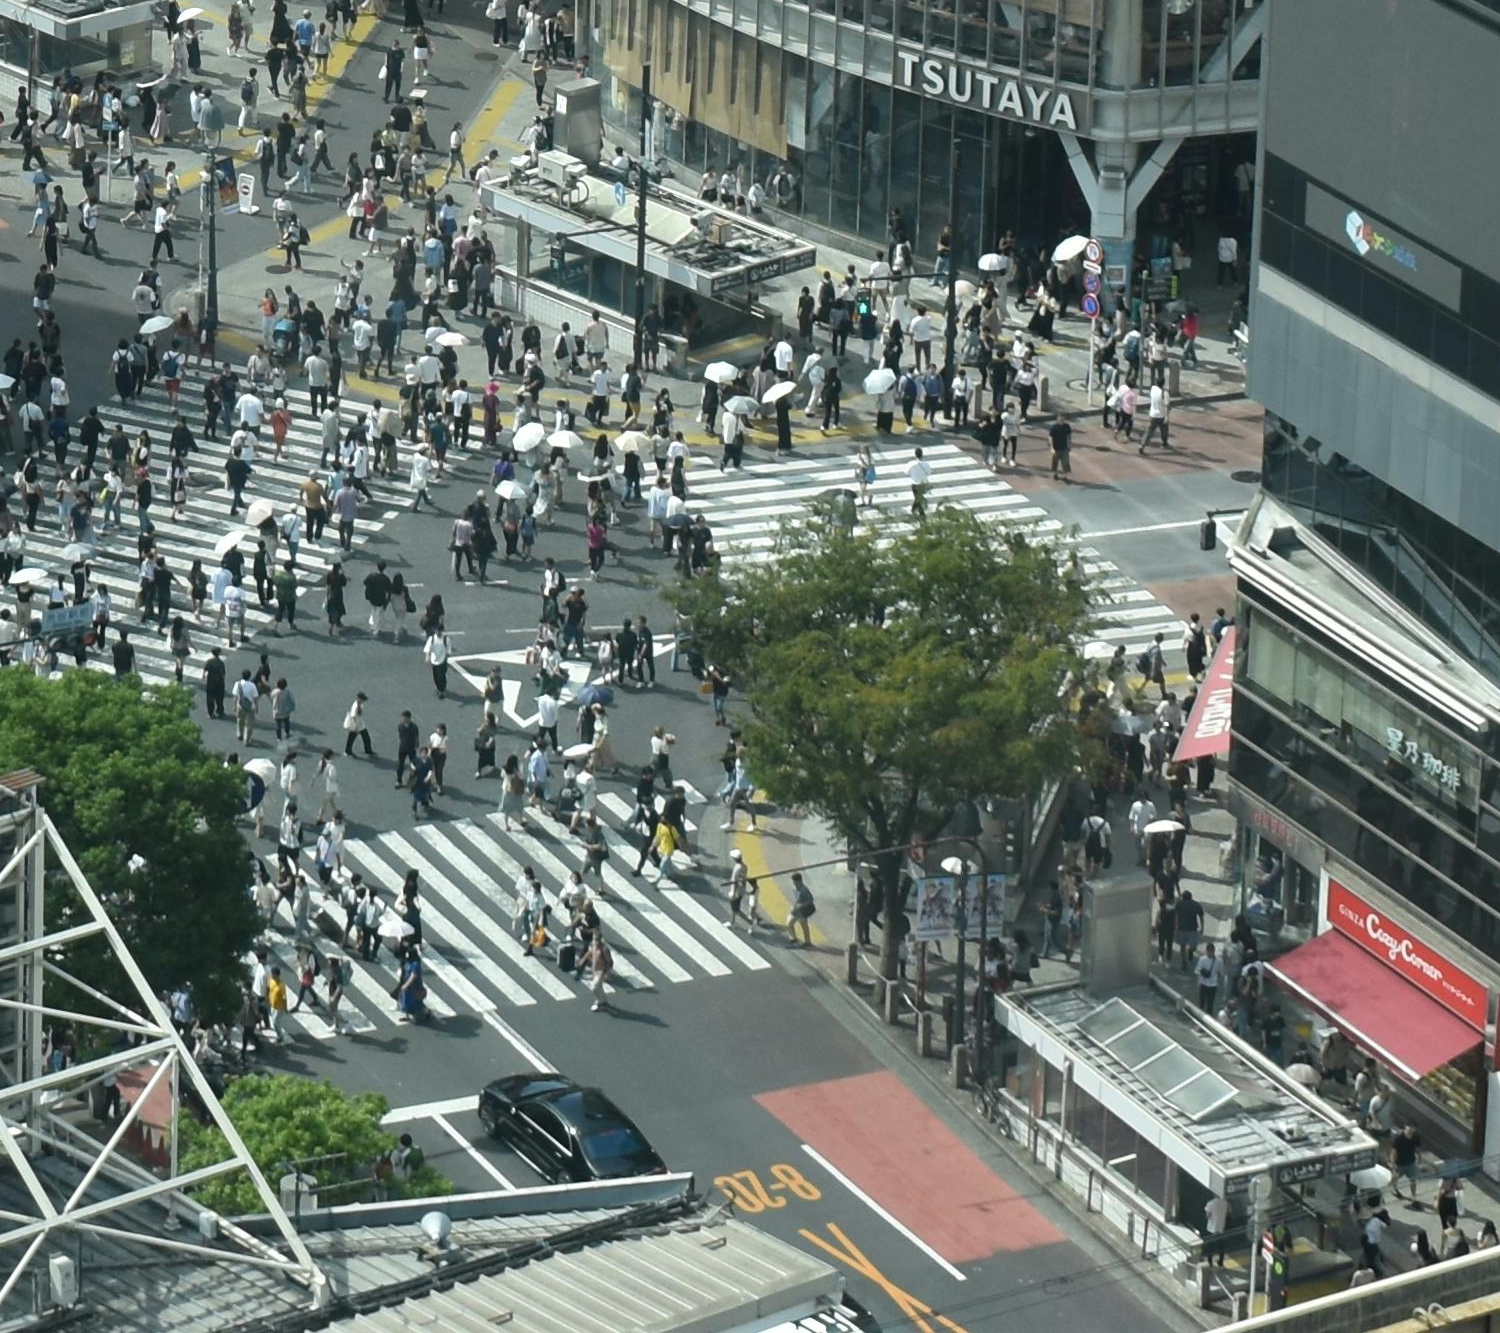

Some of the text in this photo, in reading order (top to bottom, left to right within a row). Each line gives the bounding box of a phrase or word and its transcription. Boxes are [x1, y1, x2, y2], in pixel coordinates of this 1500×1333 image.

[896, 51, 1078, 131] TSUTAYA
[1337, 903, 1444, 983] GINZA Cozy Corner
